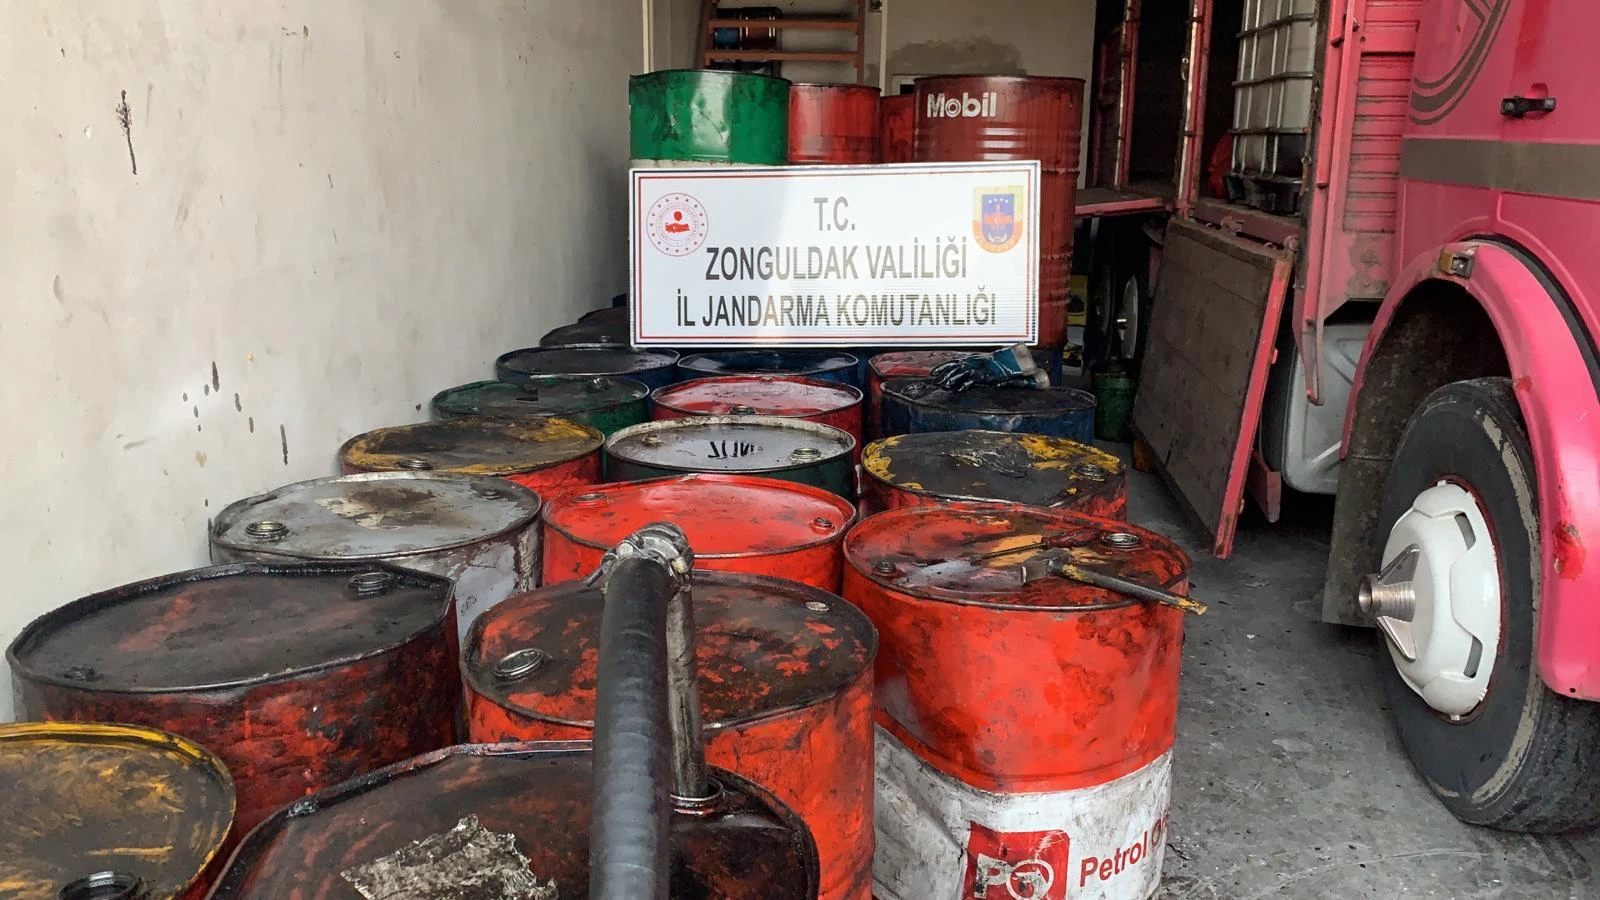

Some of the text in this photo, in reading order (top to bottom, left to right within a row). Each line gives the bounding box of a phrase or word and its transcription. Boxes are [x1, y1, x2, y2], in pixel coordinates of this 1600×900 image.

[927, 92, 997, 118] Mobil
[814, 196, 855, 231] T.C.
[705, 246, 858, 281] ZONGULDAK
[866, 235, 967, 279] VALİLİĞİ
[677, 285, 996, 327] İL JANDARMA KOMUTANLIĞI
[1080, 830, 1148, 888] Petrol
